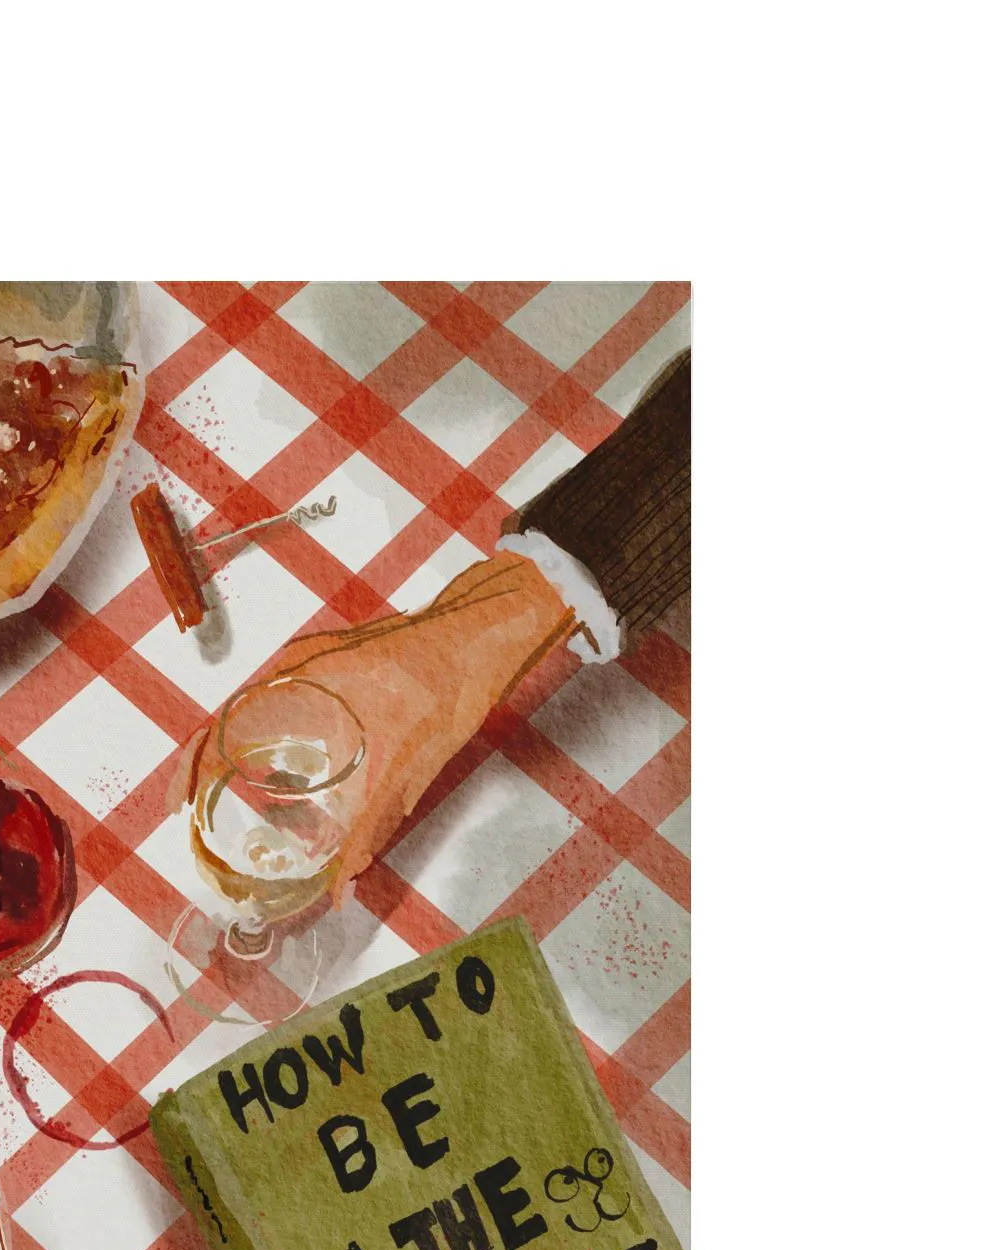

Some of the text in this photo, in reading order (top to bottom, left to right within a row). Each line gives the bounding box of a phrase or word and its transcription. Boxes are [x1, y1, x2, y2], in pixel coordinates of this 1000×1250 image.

[217, 956, 496, 1134] HOW TO
[317, 1071, 451, 1194] BE
